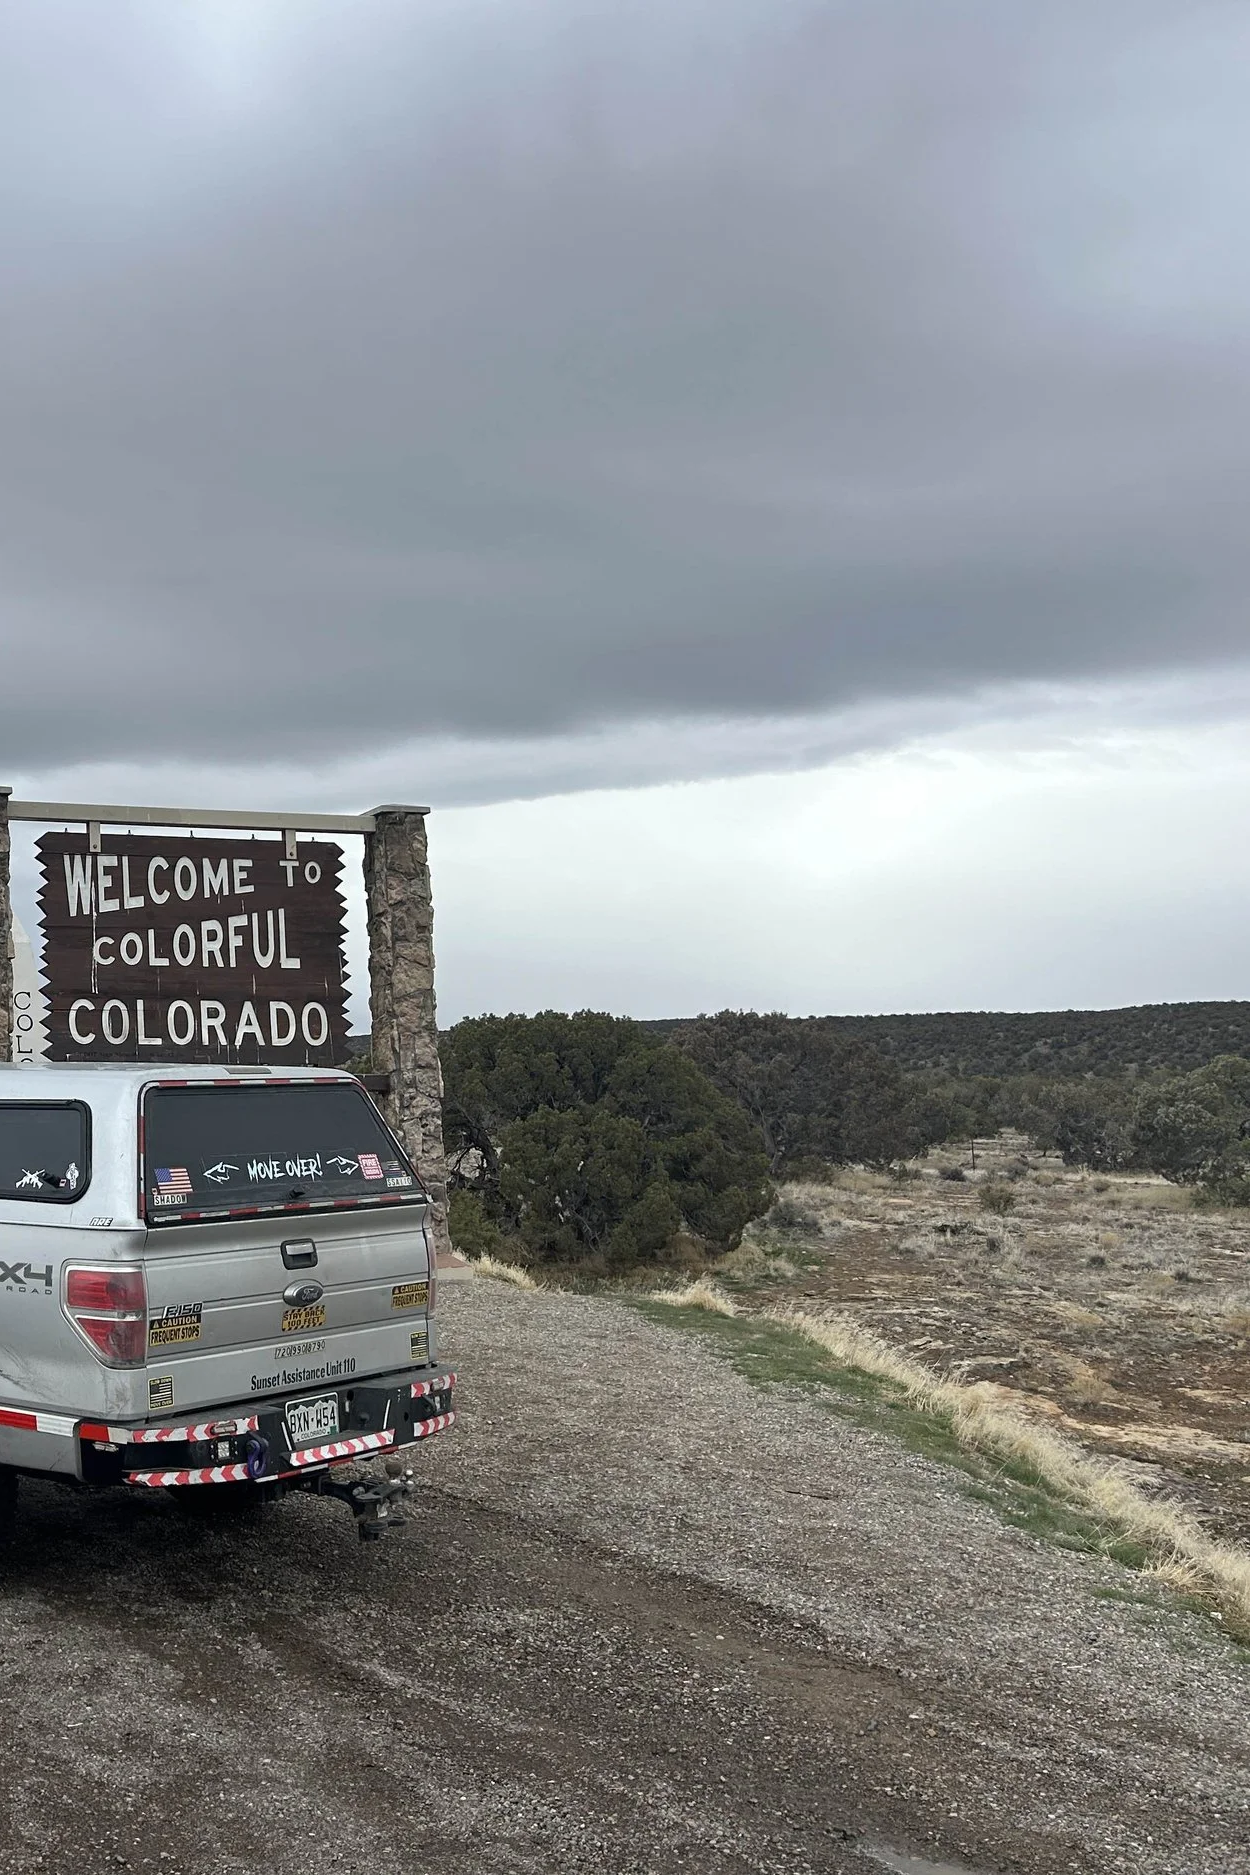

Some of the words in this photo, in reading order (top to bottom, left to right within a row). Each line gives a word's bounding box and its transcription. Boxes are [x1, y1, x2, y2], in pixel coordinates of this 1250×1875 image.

[63, 854, 255, 917] WELCOME
[94, 908, 301, 969] COLORFUL
[14, 991, 34, 1063] COL
[68, 999, 328, 1047] COLORADO
[247, 1154, 285, 1184] MOVE
[285, 1152, 323, 1182] OVER!
[361, 1159, 377, 1167] FIRE
[154, 1194, 187, 1205] SHADOW
[400, 1283, 427, 1294] CAUTION
[392, 1293, 414, 1308] FREQUENT
[414, 1290, 428, 1304] STOPS
[161, 1315, 198, 1328] CAUTION
[283, 1311, 304, 1320] STAY
[304, 1309, 325, 1318] BACK
[288, 1320, 302, 1328] 100
[303, 1316, 321, 1325] FEET
[151, 1327, 180, 1344] FREQUENT
[180, 1324, 200, 1339] STOPS
[251, 1372, 280, 1391] Sunset
[281, 1366, 325, 1385] Assistance
[326, 1361, 342, 1376] Unit
[343, 1357, 356, 1373] 110
[300, 1428, 327, 1440] COLORADO
